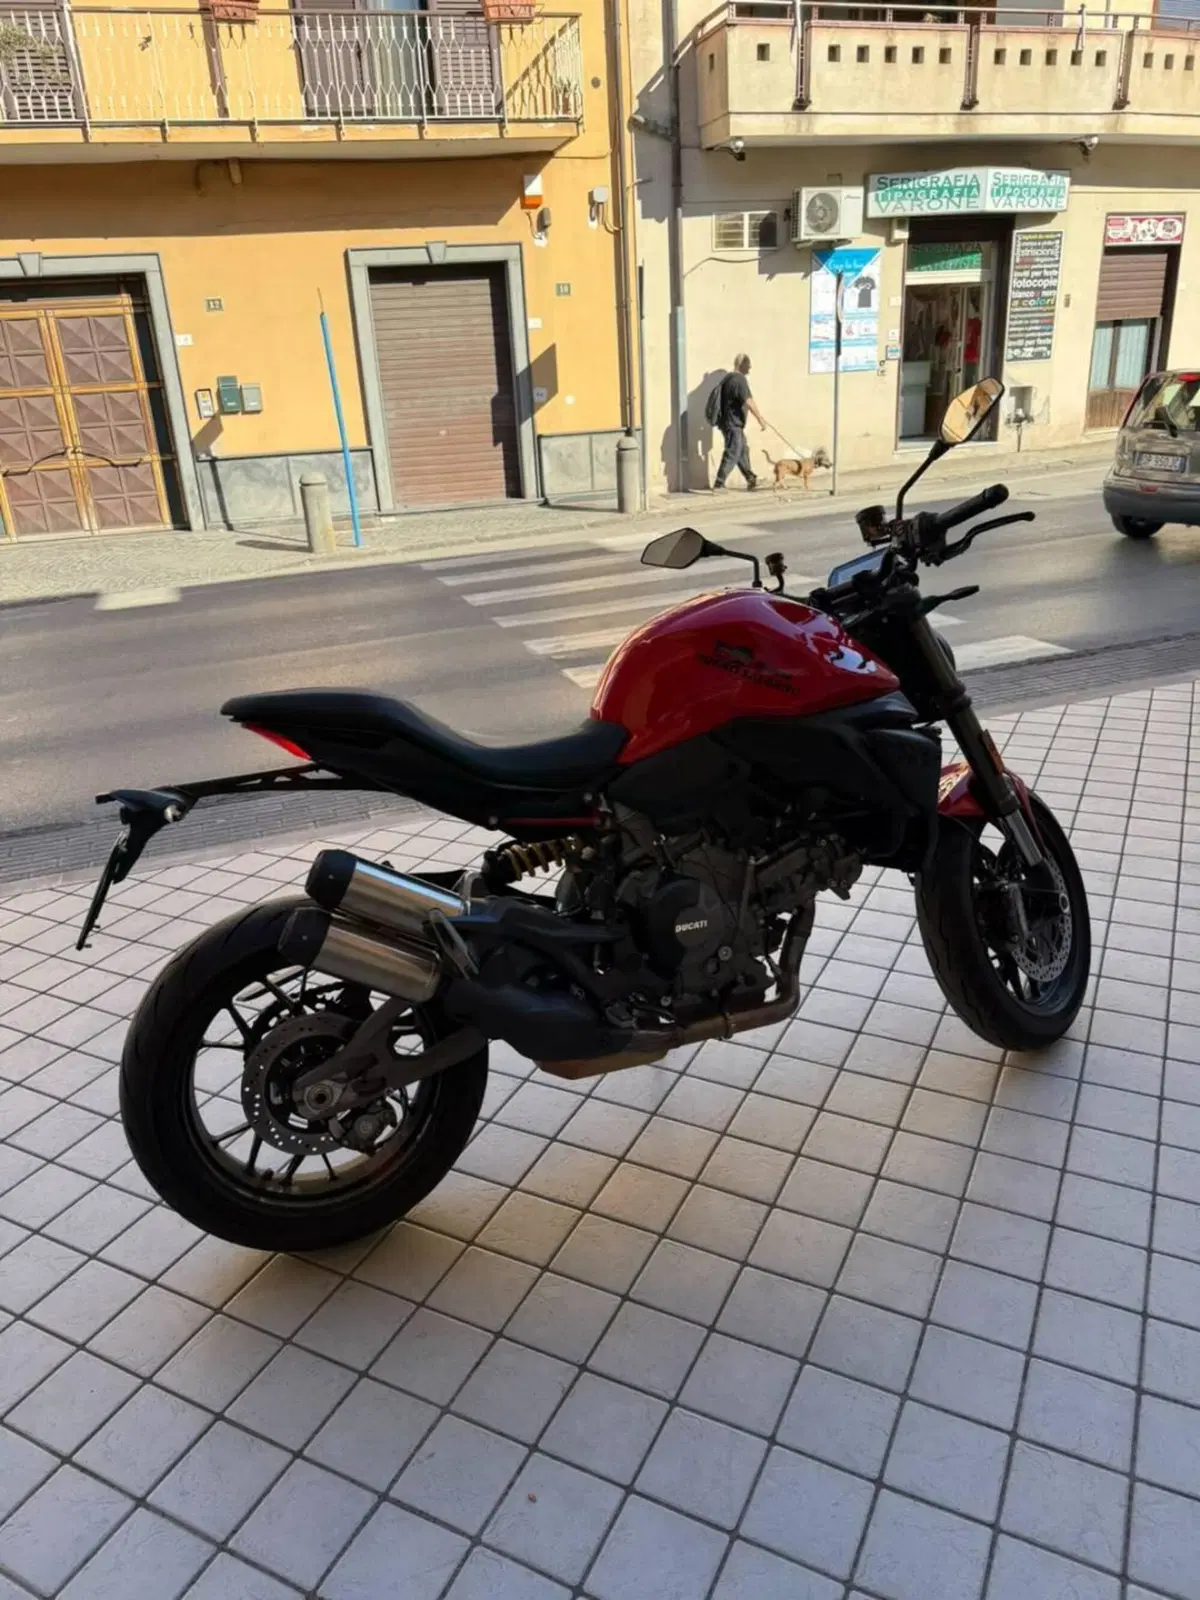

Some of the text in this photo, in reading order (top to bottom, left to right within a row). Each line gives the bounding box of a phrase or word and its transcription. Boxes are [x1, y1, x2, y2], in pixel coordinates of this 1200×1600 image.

[876, 174, 980, 190] SERIGRAFIA
[992, 171, 1066, 187] SERIGRAFIA
[877, 186, 979, 202] TIPOGRAFIA
[993, 186, 1065, 197] TIPOGRAFIA
[876, 198, 979, 213] VARONE
[991, 196, 1065, 209] VARONE
[1012, 277, 1058, 289] fotocopie
[675, 920, 708, 933] DUCATI
